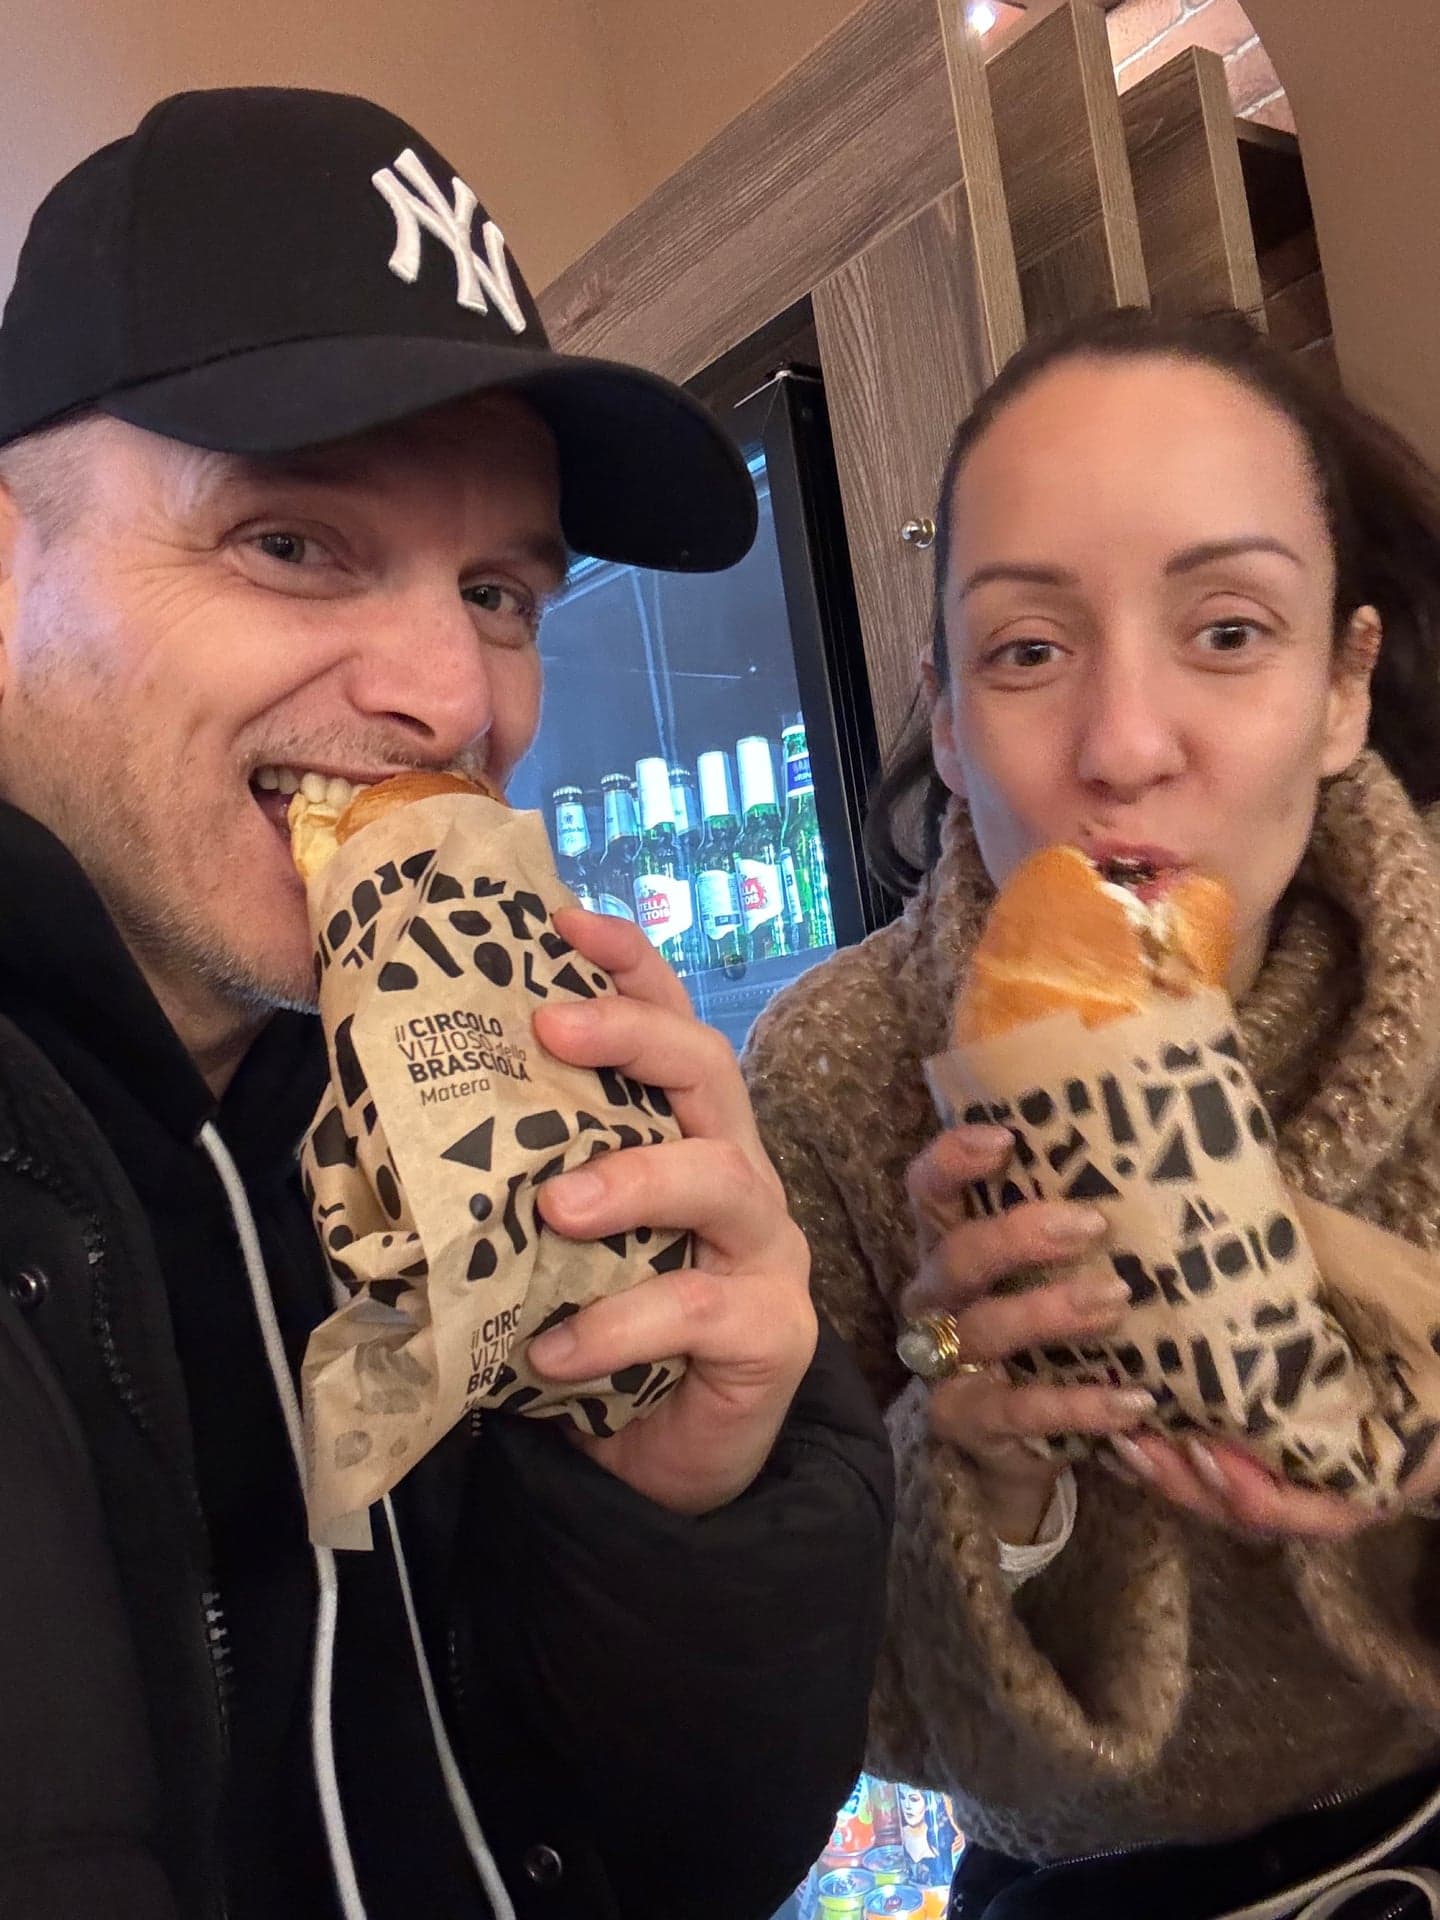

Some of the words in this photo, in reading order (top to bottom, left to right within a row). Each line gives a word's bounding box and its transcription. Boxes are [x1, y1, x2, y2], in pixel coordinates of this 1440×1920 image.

[371, 148, 527, 335] NY
[408, 1010, 503, 1038] CIRCOLO
[398, 1030, 493, 1062] VIZIOSO
[407, 1051, 532, 1083] BRASCIOLA
[420, 1078, 490, 1106] Matera
